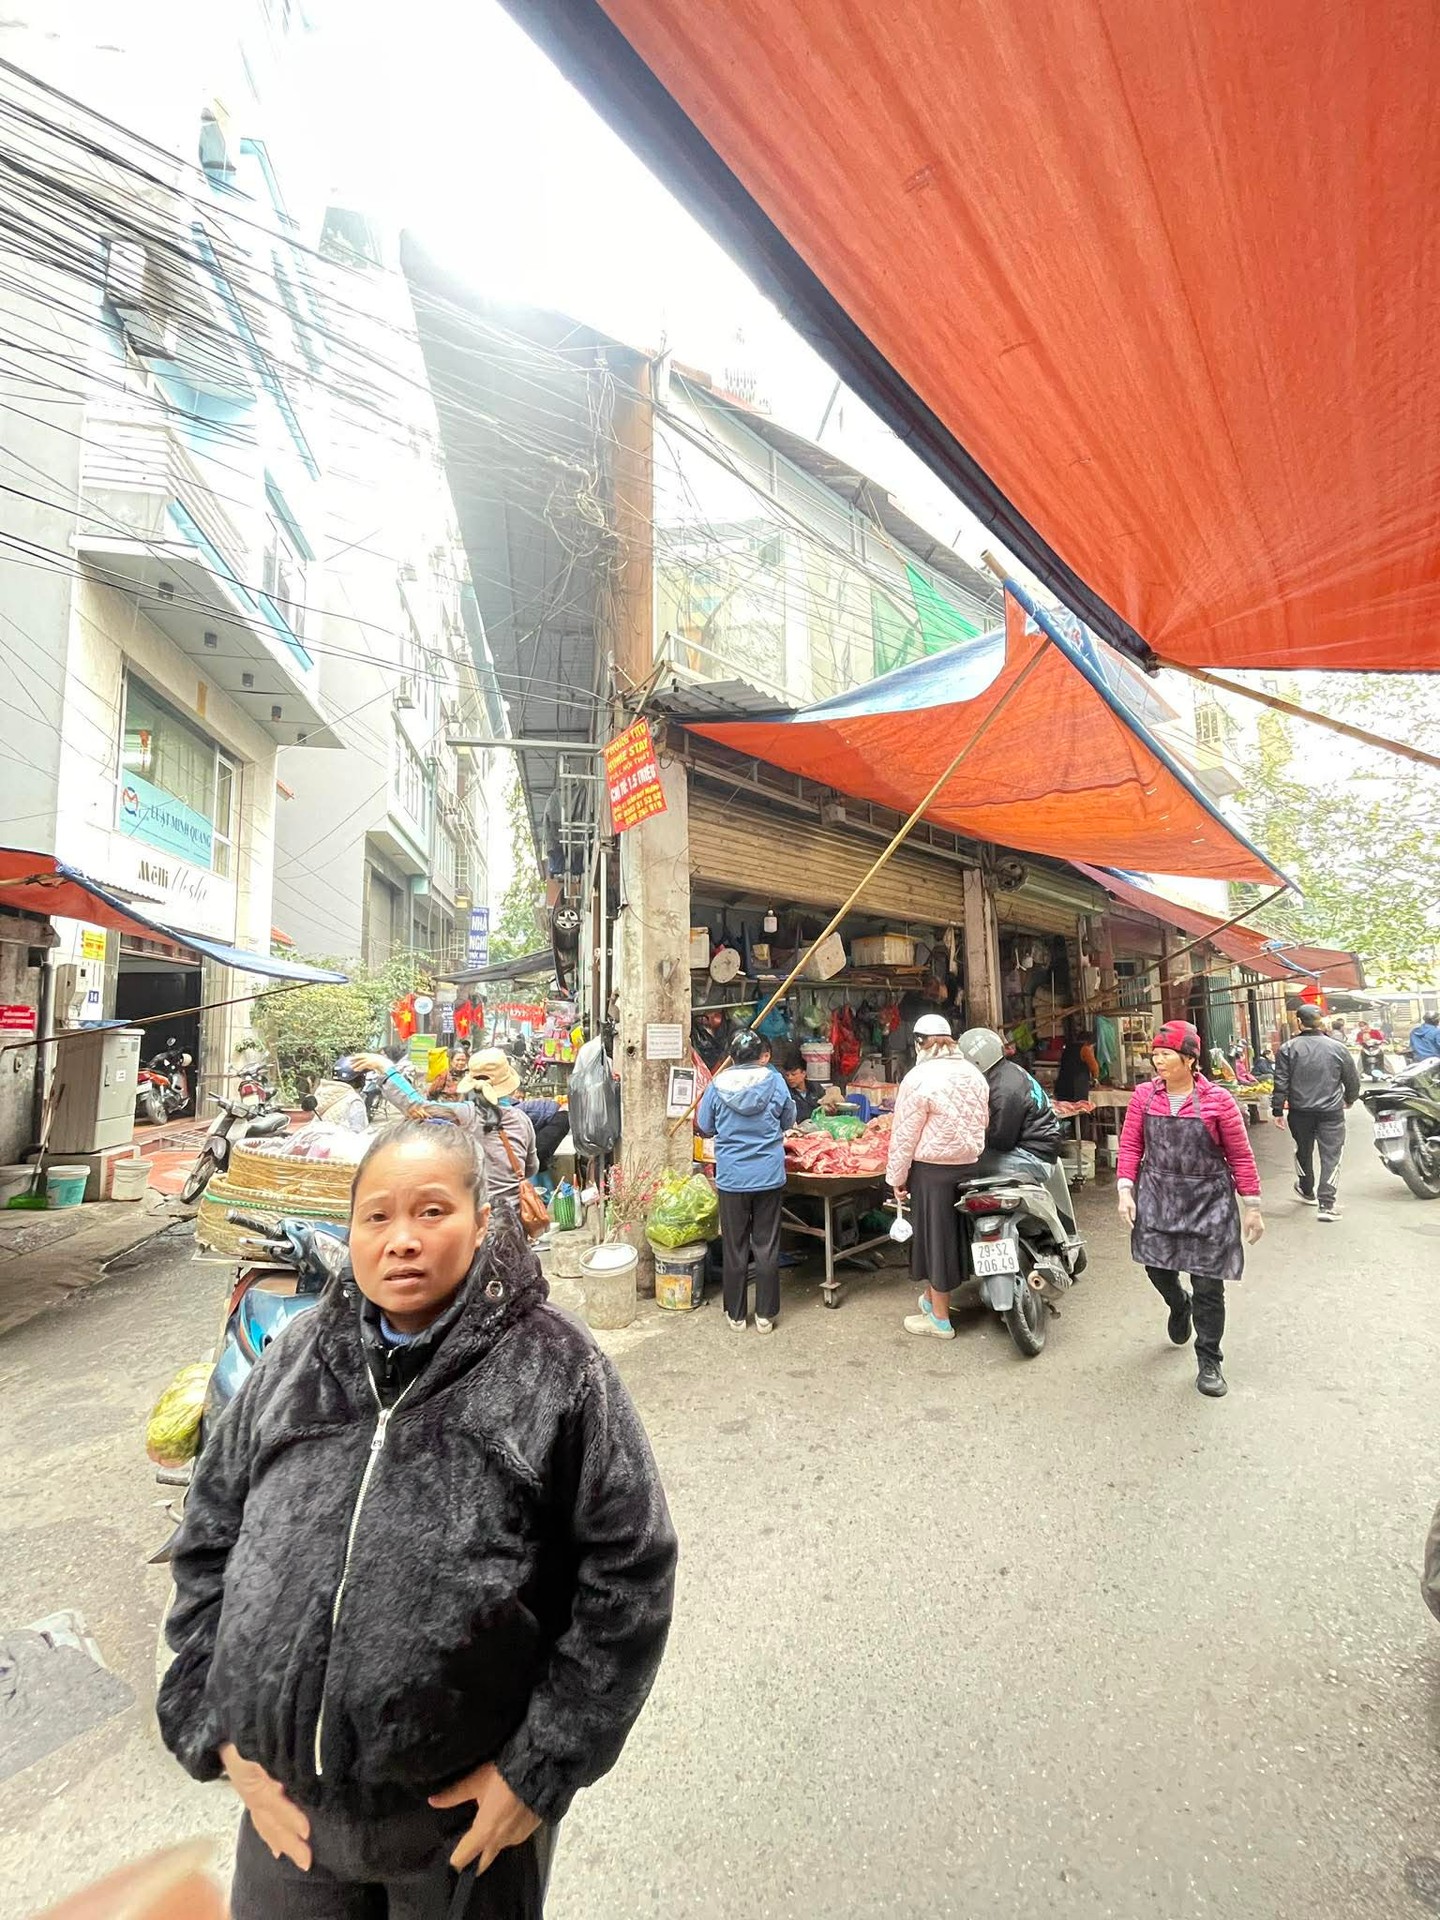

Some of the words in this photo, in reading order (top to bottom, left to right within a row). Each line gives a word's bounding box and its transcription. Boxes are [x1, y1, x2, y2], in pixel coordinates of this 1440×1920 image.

[629, 738, 648, 758] STAY
[171, 816, 189, 836] MINH
[190, 826, 212, 848] QUANG
[976, 1257, 1016, 1274] 206.49
